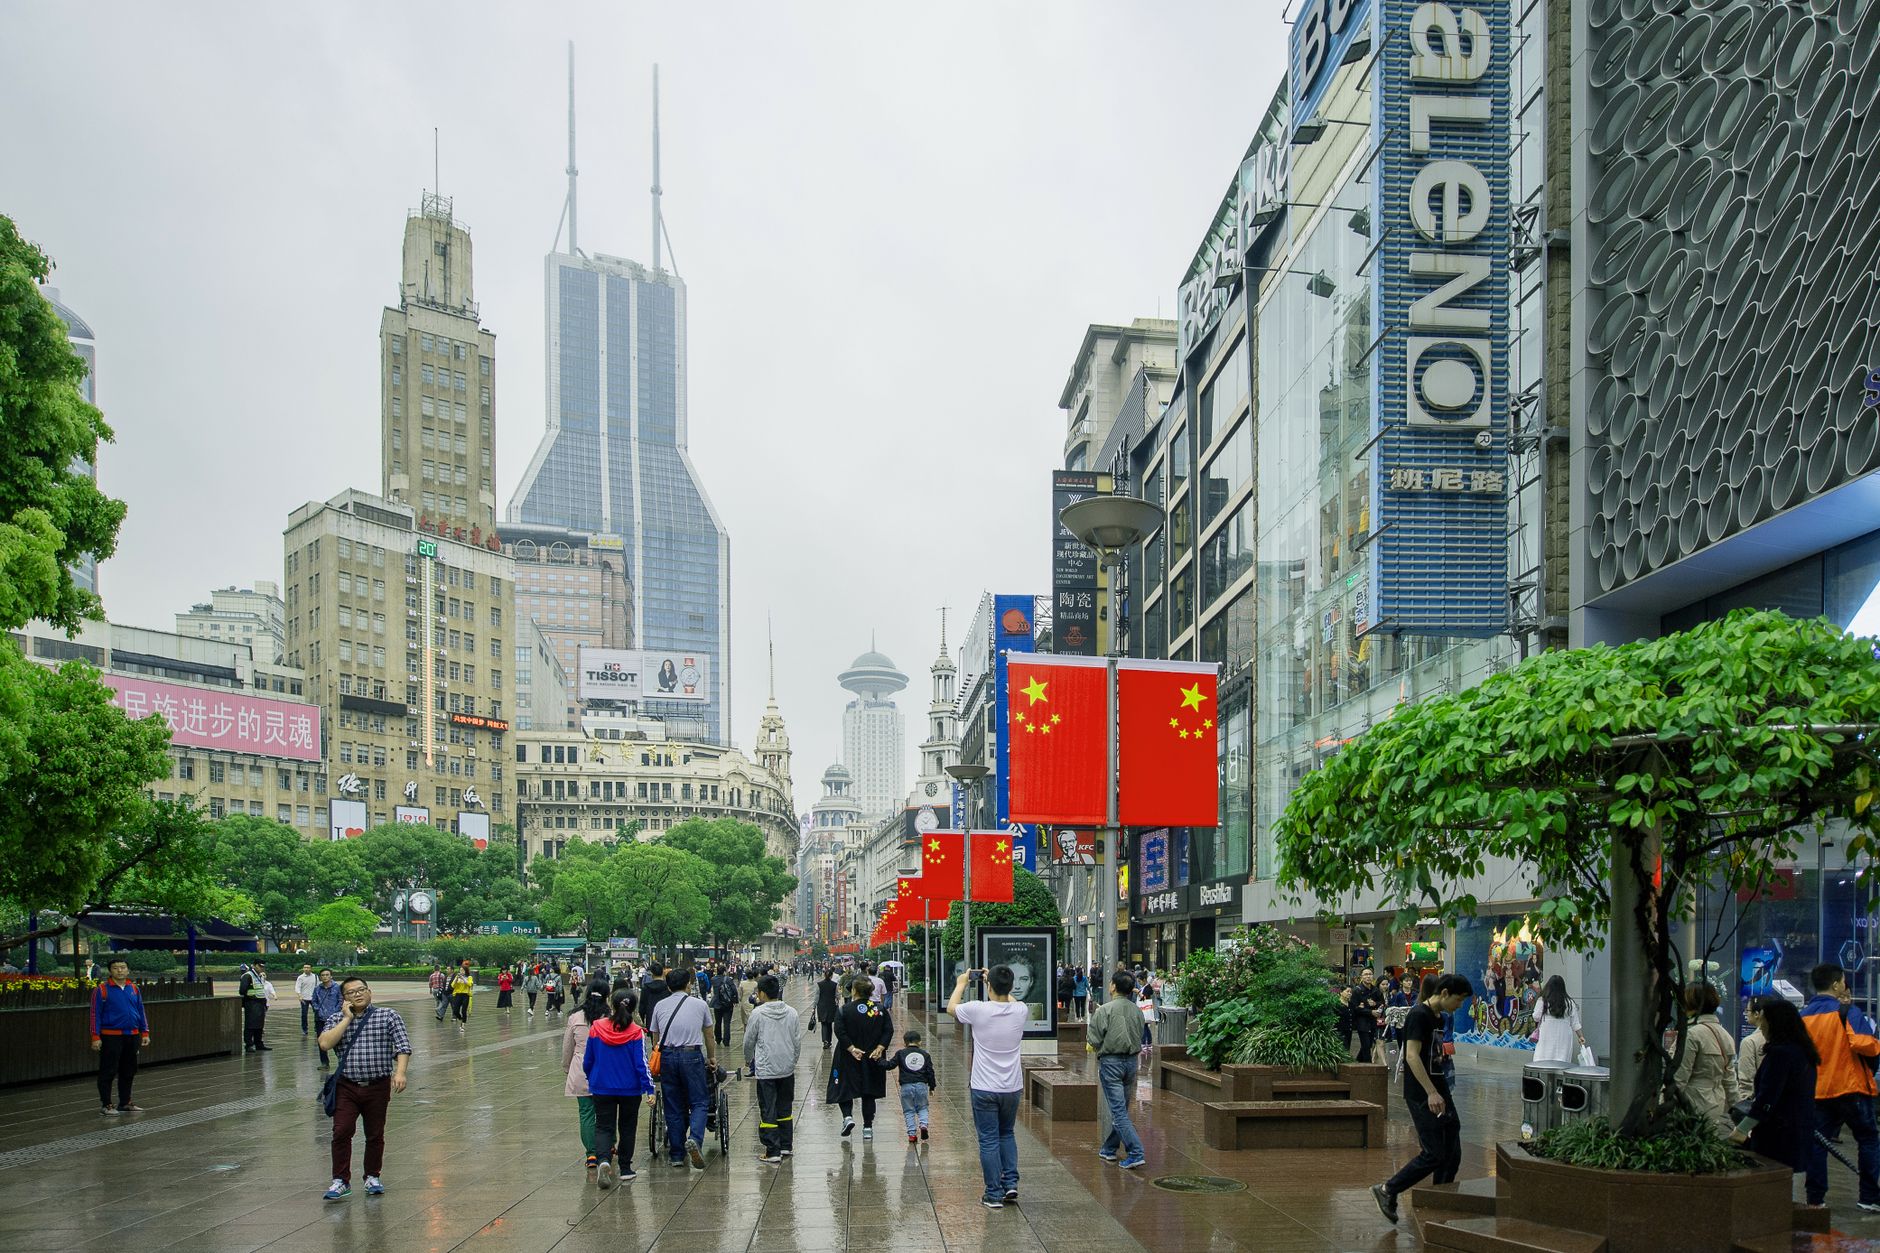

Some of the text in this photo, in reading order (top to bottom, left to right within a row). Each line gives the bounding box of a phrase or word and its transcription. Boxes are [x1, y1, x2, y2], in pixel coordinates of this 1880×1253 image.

[1390, 467, 1504, 492] 班尼路
[1059, 592, 1092, 608] 陶瓷
[1060, 611, 1089, 621] 精品商场
[586, 670, 638, 682] TISSOT
[107, 690, 314, 750] 民族进步的灵魂
[512, 926, 532, 934] Chez
